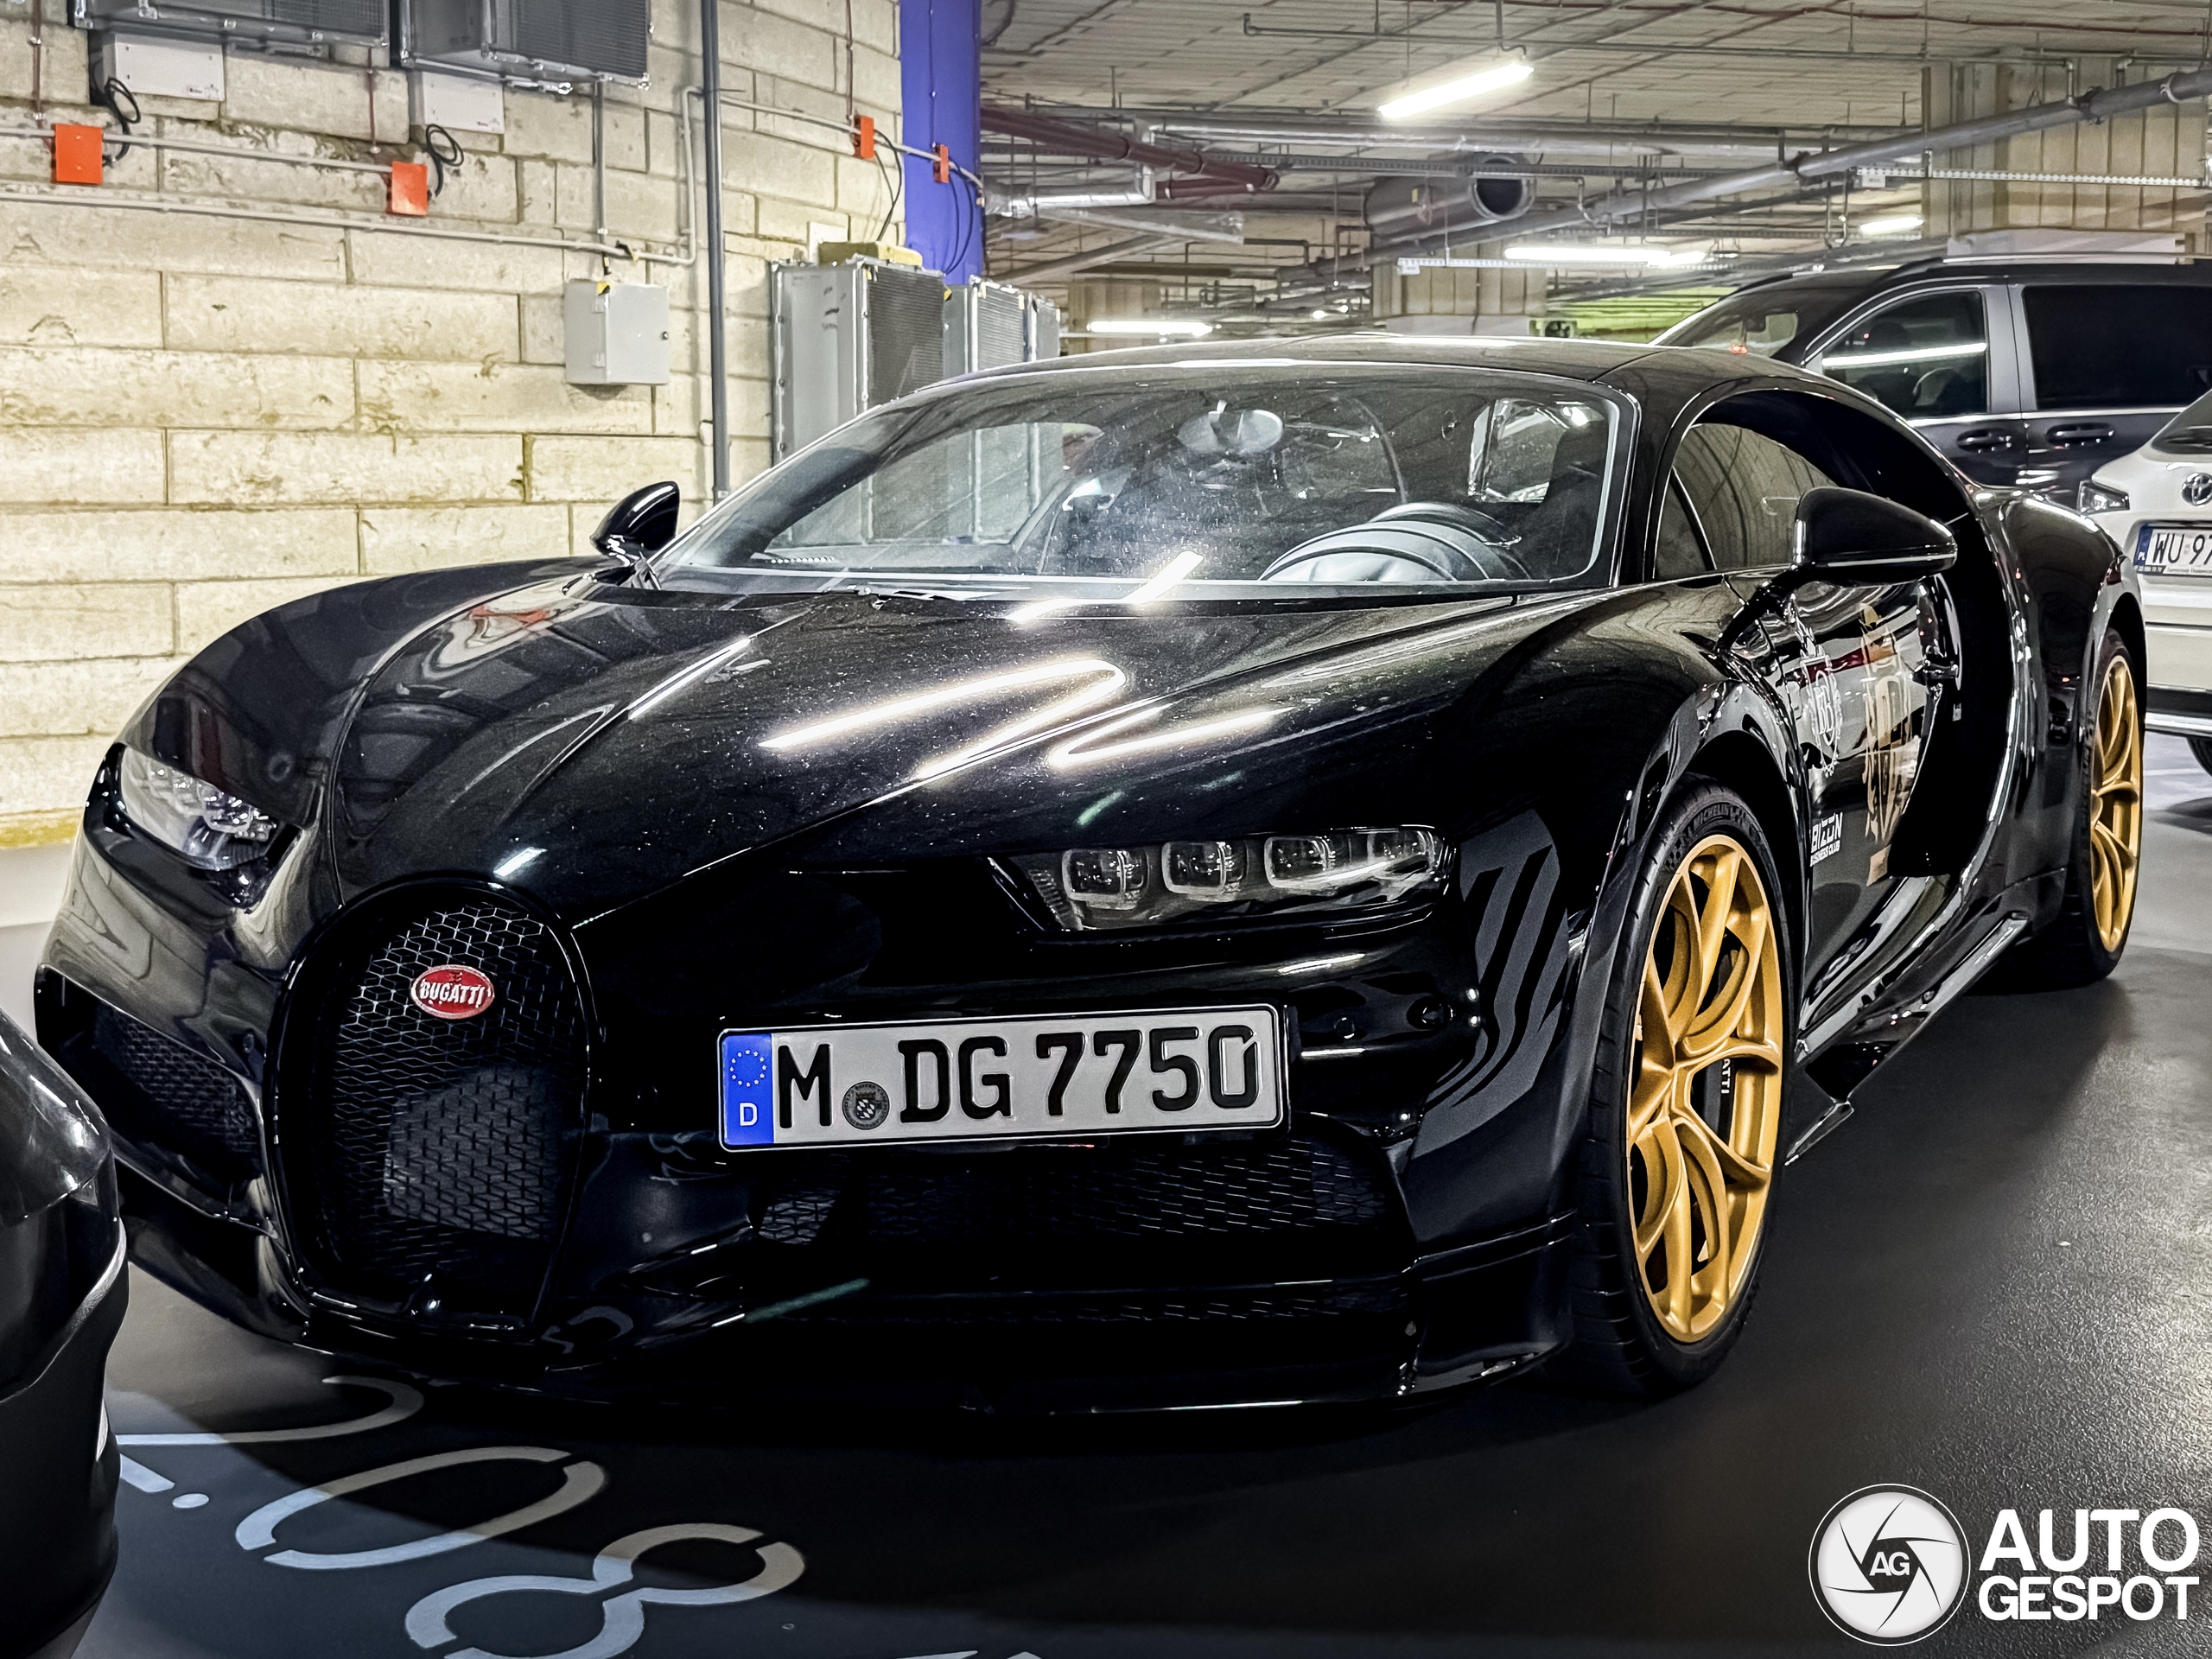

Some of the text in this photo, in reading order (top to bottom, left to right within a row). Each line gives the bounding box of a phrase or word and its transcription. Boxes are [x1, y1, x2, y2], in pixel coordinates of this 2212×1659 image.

[2138, 551, 2145, 561] PL
[2152, 532, 2185, 563] WU
[1811, 811, 1843, 854] BIZON
[419, 978, 486, 1009] BUGATTI
[778, 1042, 833, 1129] M
[897, 1035, 1013, 1123] DG
[1036, 1025, 1260, 1116] 7750
[739, 1102, 759, 1127] D
